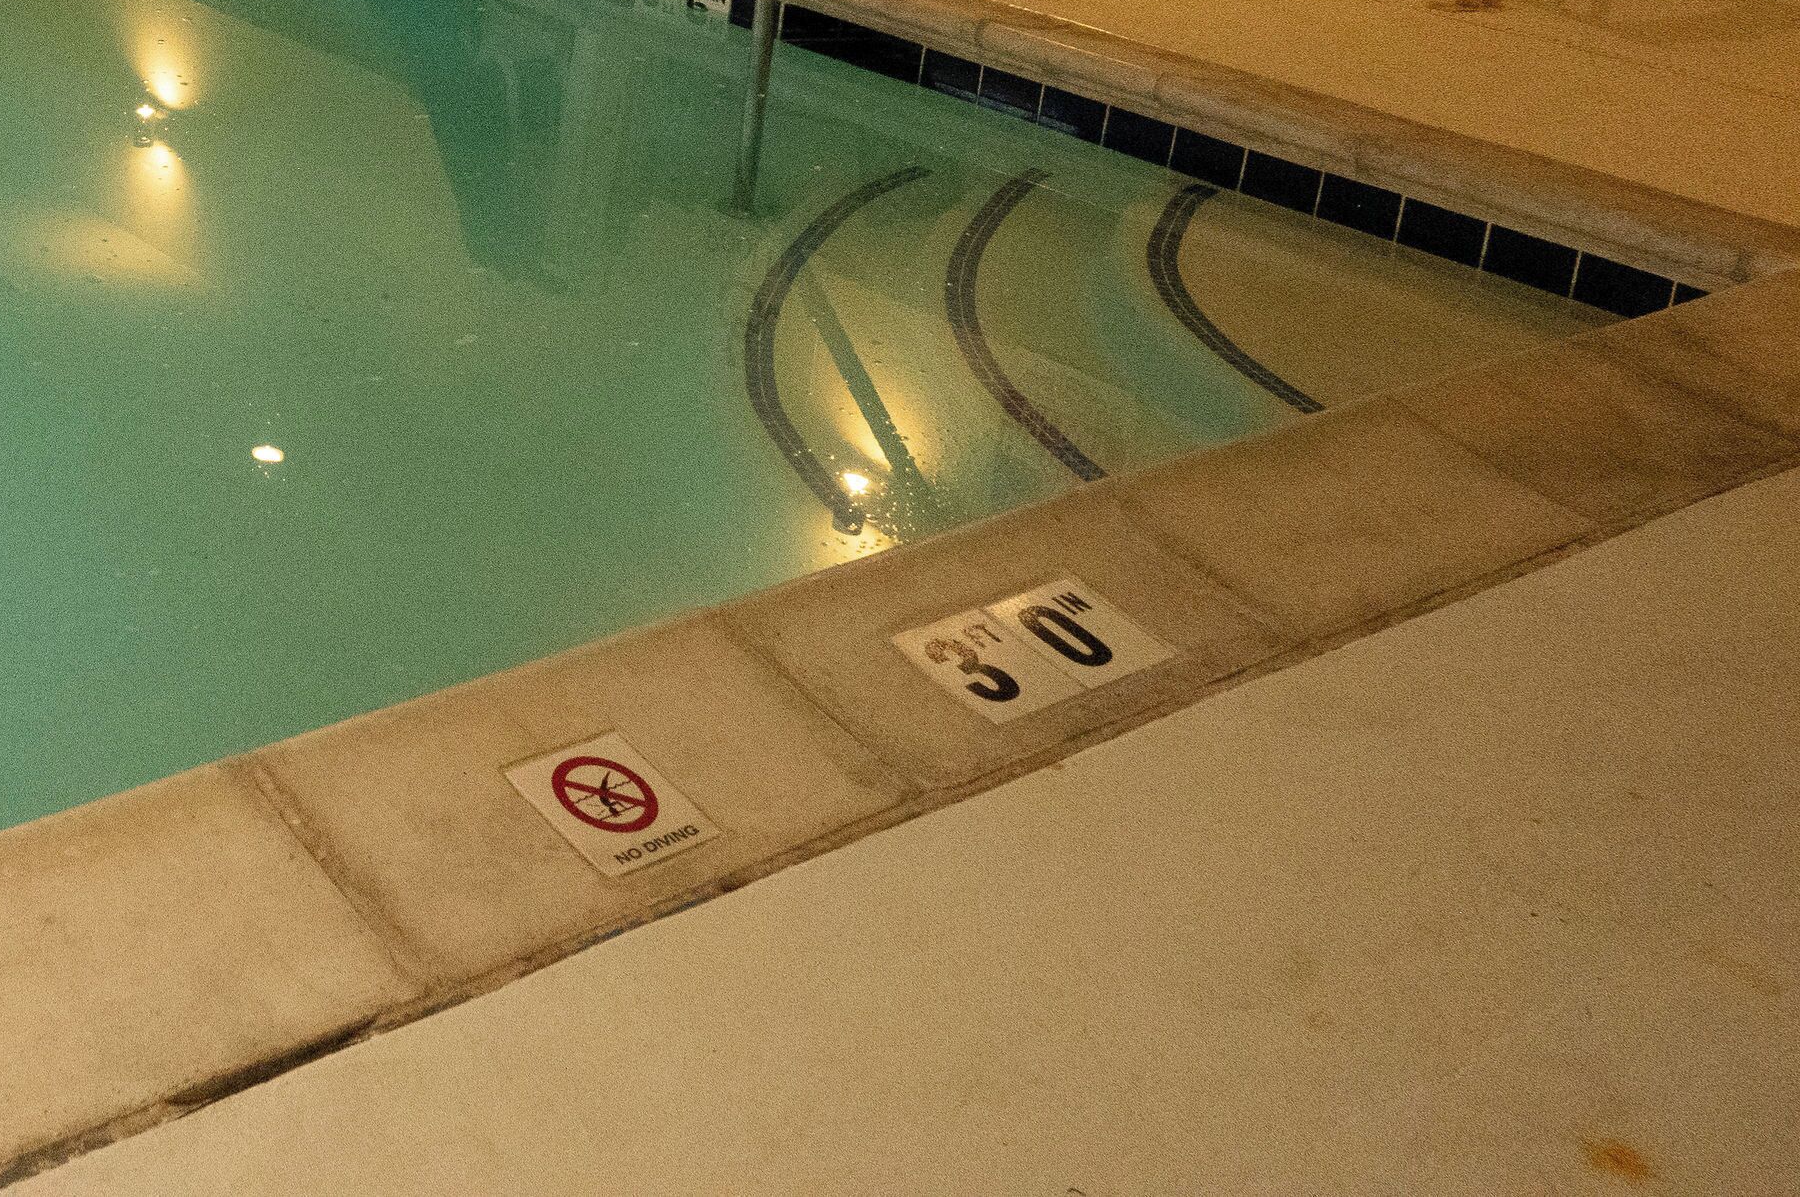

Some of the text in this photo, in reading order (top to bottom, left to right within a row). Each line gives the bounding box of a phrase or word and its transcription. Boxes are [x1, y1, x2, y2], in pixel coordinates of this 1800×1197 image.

[924, 590, 1114, 703] 3 FT 0 IN
[612, 823, 701, 866] NO DIVING
